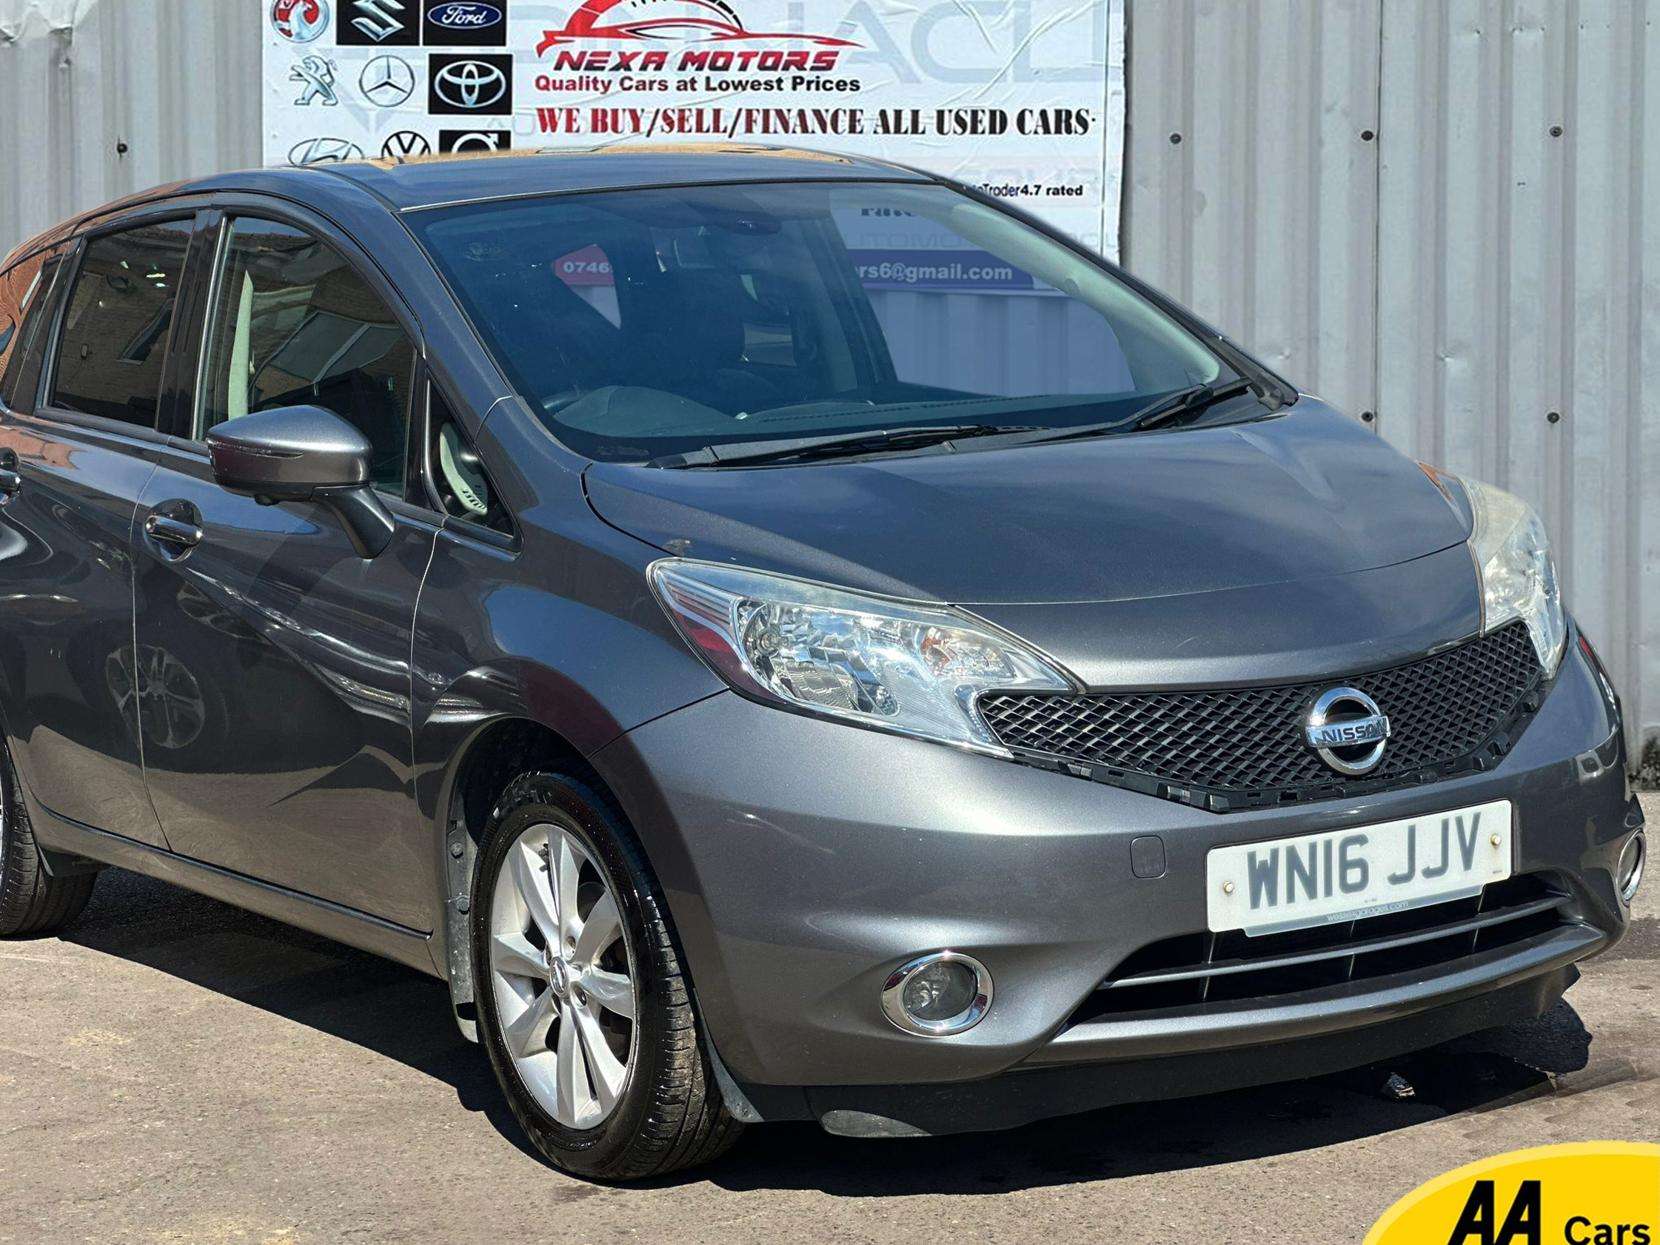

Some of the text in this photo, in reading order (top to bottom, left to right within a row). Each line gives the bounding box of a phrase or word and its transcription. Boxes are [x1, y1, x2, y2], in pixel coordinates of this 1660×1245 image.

[442, 7, 488, 24] Ford
[553, 51, 839, 72] NEXA MOTORS
[535, 76, 861, 95] Quality Cars at Lowest Prices
[537, 107, 580, 133] WE
[873, 108, 927, 135] ALL
[935, 108, 1008, 135] USED
[1046, 184, 1083, 196] rated
[563, 261, 614, 273] 0746
[854, 262, 1014, 283] rs6@gmail.com
[1322, 719, 1387, 743] NISSAN
[1246, 812, 1481, 910] WN16 JJV
